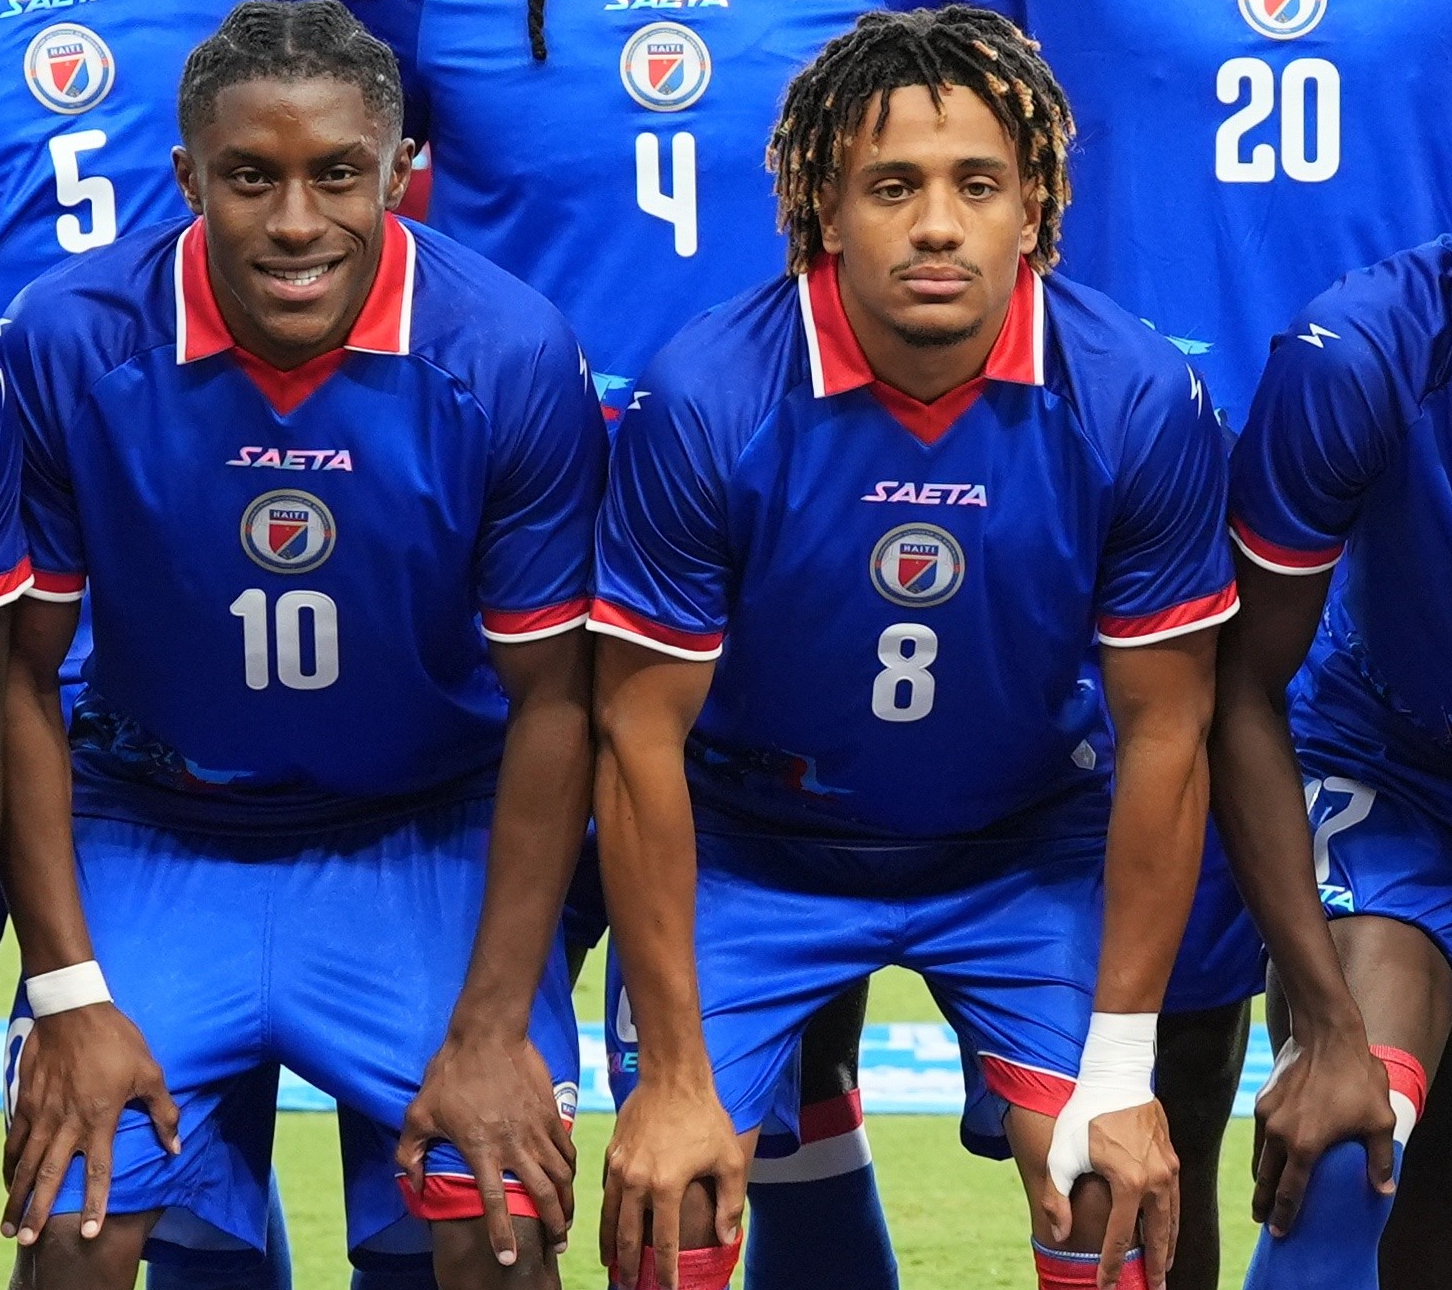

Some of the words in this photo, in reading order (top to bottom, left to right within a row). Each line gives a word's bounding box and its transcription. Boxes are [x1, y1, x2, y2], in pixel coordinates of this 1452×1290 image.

[50, 43, 82, 57] HAITI
[649, 44, 682, 54] HAITI
[1215, 58, 1340, 182] 20
[49, 129, 116, 253] 5
[635, 131, 697, 257] 4
[225, 446, 353, 471] SAETA
[861, 481, 988, 507] SAETA
[272, 510, 305, 520] HAITI
[902, 544, 936, 554] HAITI
[229, 588, 339, 690] 10
[871, 622, 938, 722] 8
